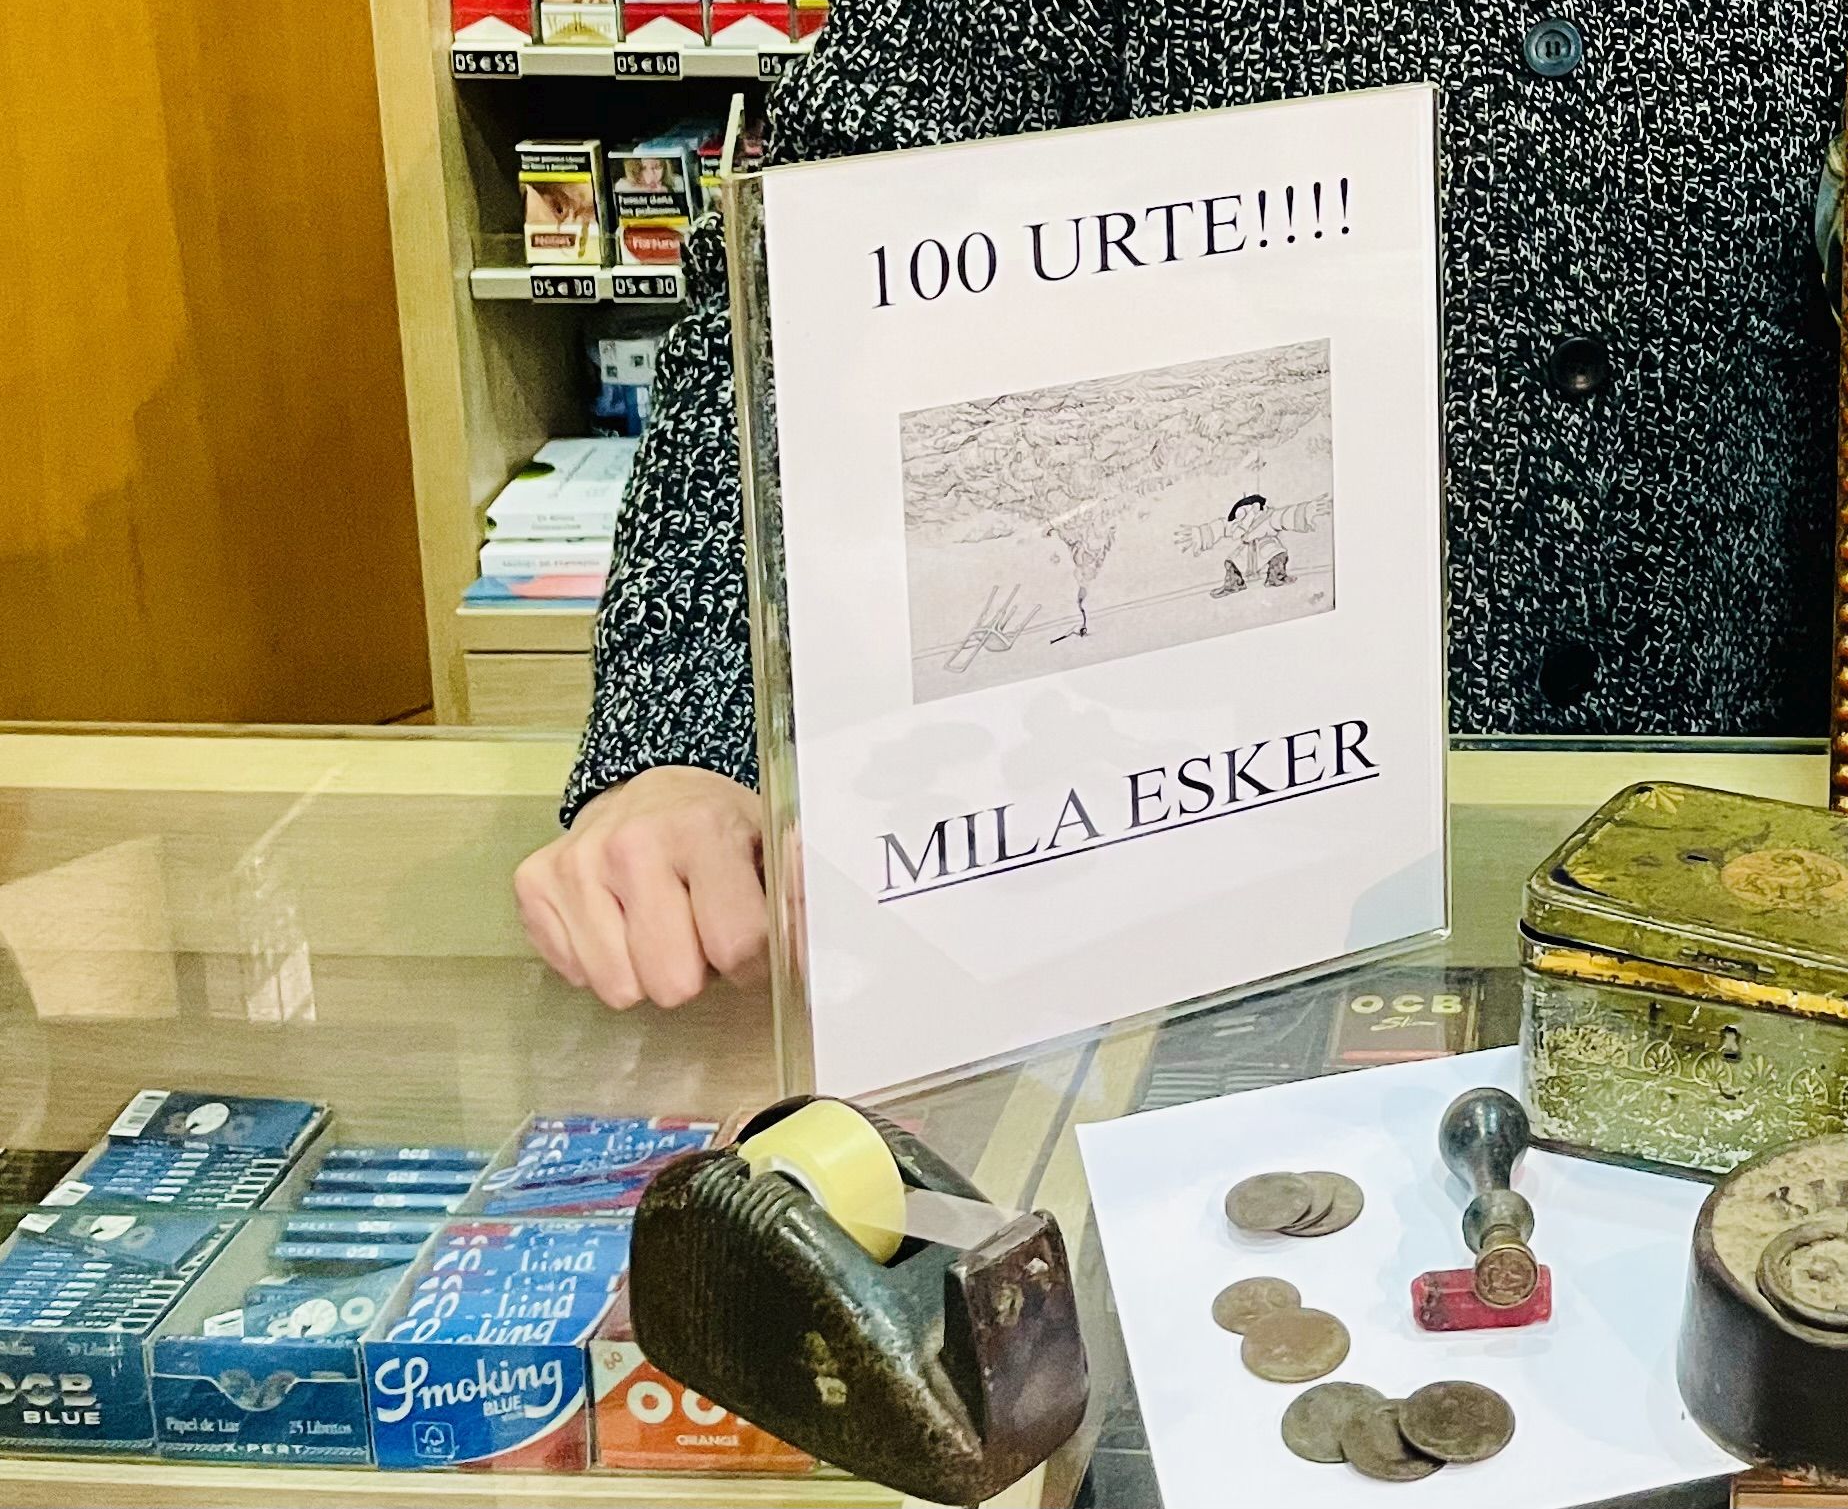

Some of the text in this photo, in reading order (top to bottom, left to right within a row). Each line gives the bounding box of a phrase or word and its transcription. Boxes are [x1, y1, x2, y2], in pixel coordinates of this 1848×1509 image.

[868, 177, 1351, 309] 100 URTE!!!!
[877, 719, 1379, 891] MILA ESKER
[1350, 994, 1463, 1015] OCB
[374, 1357, 563, 1423] Smoking
[483, 1397, 524, 1418] BLUE
[626, 1380, 745, 1426] OC
[23, 1410, 101, 1425] BLUE
